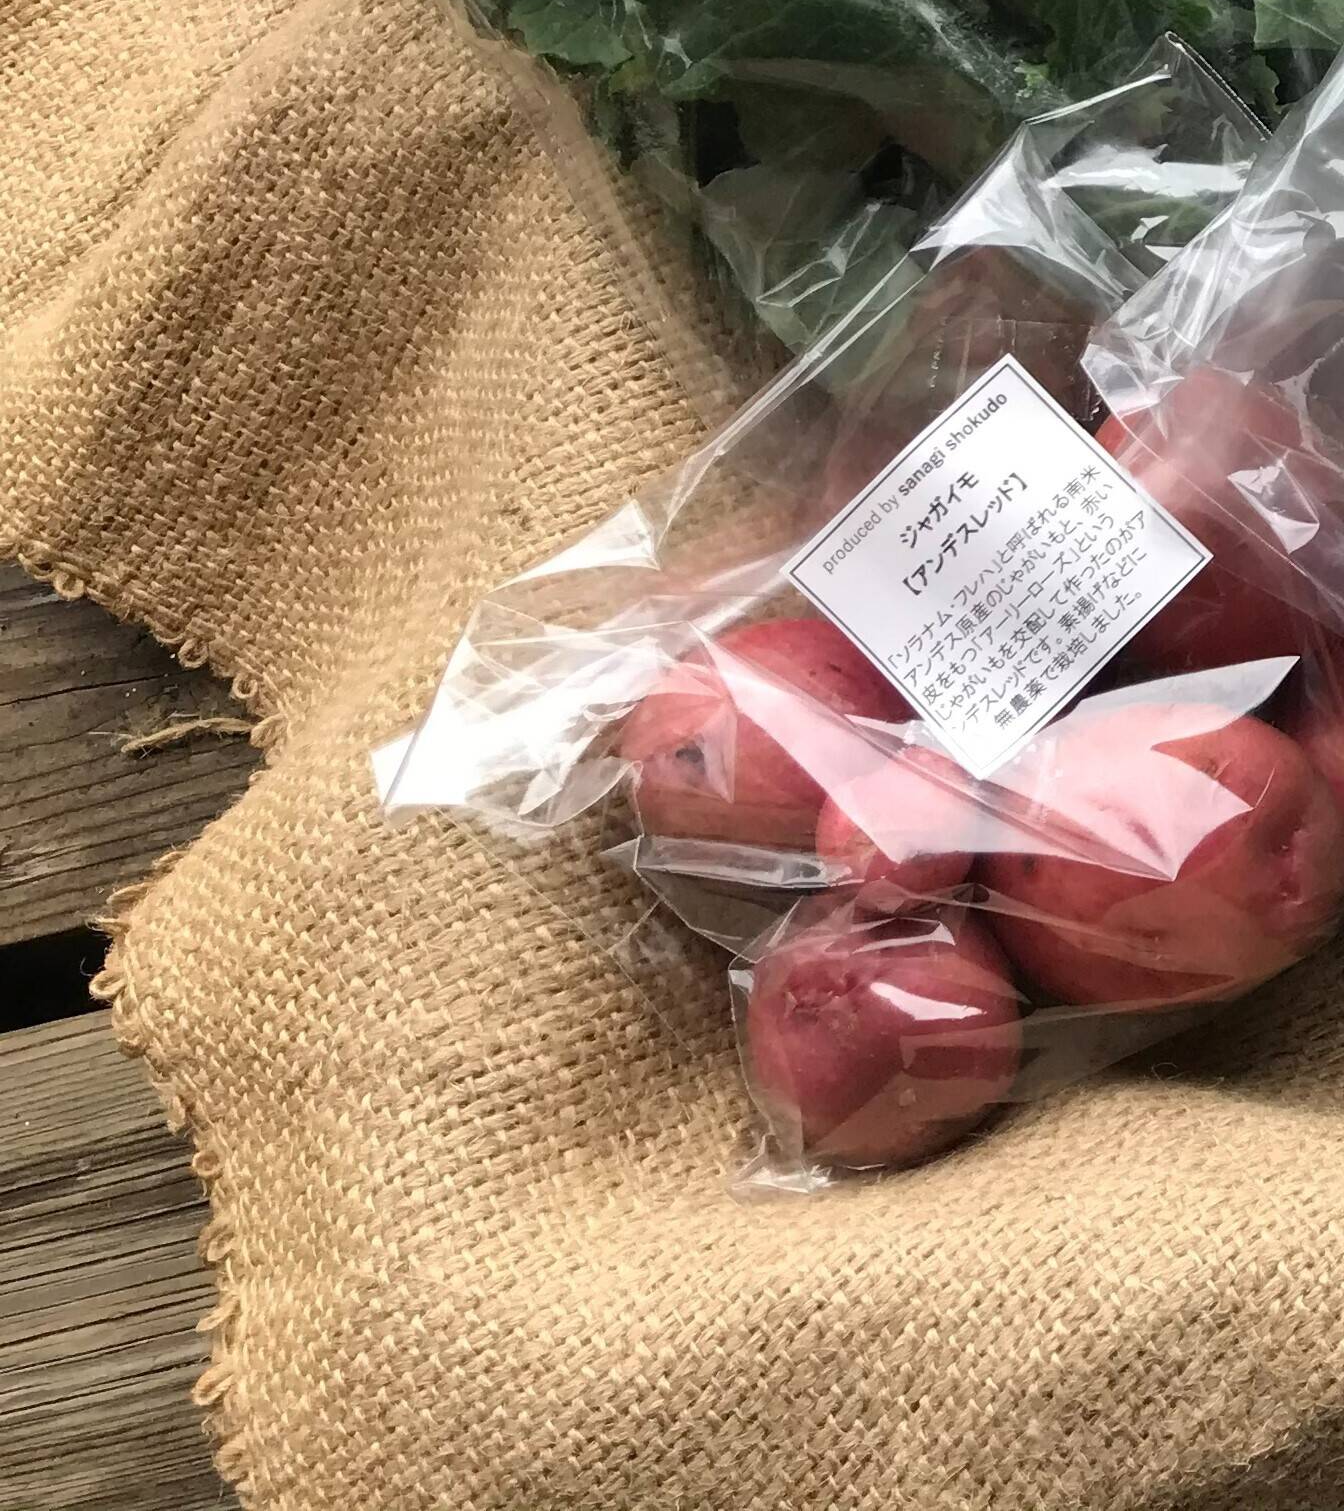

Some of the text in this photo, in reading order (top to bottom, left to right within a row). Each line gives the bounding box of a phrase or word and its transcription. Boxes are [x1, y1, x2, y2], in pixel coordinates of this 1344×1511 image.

[821, 393, 1007, 575] produced by sanagi shokudo
[898, 470, 980, 549] ジャガイモ
